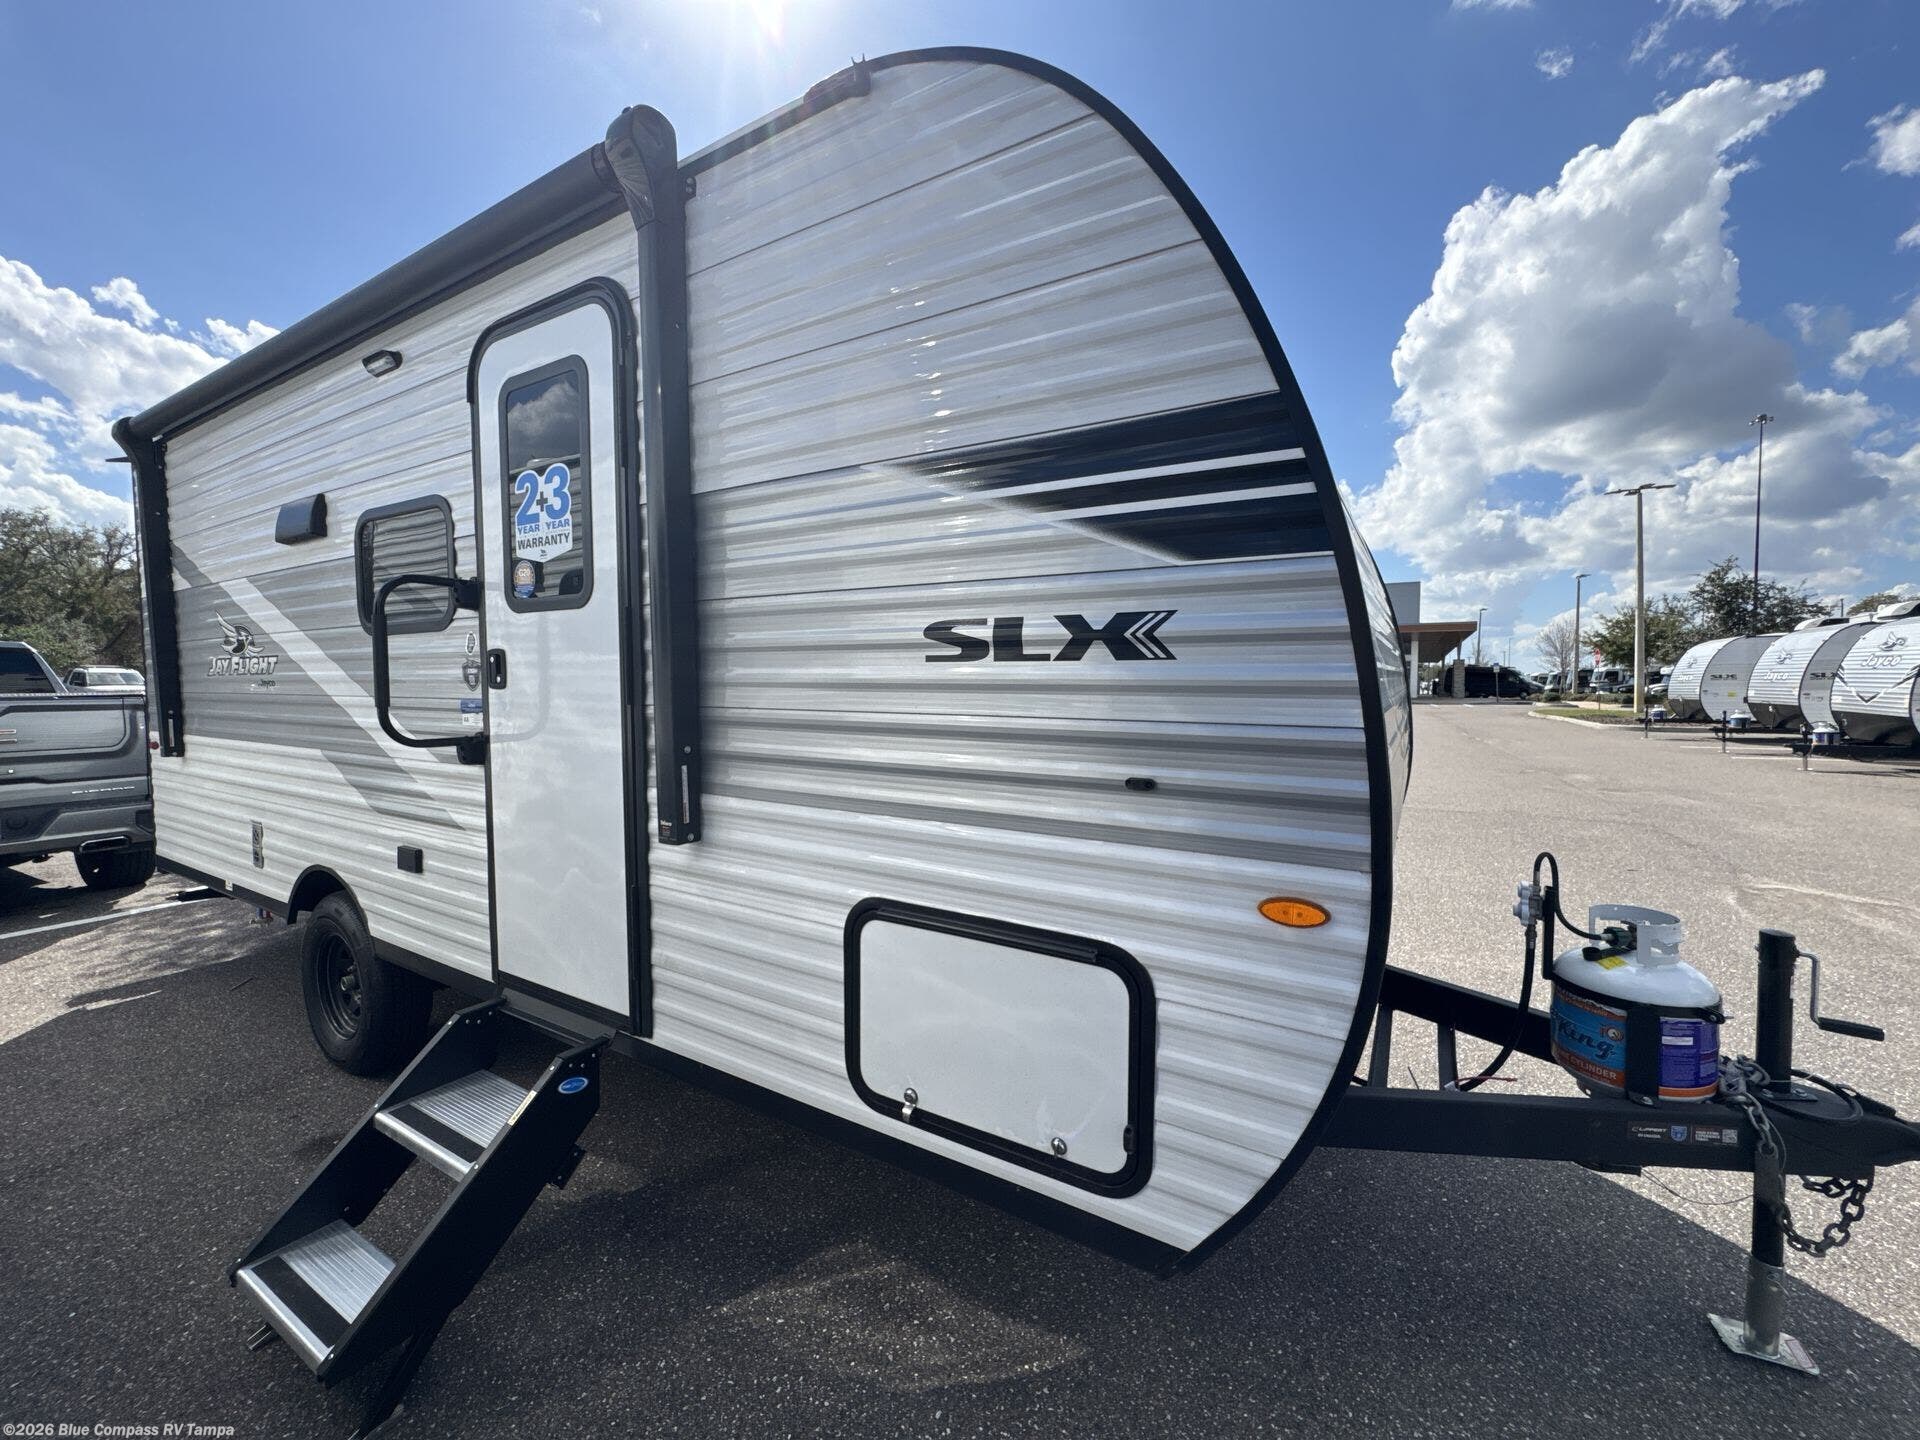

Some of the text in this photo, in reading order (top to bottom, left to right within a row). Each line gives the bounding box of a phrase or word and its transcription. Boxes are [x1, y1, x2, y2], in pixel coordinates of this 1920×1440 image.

[517, 524, 540, 535] YEAR
[545, 519, 570, 530] YEAR
[517, 533, 570, 550] WARRANTY
[923, 611, 1177, 662] SLX
[207, 655, 278, 676] JAY FLIGHT
[1860, 654, 1902, 669] Jayco
[1764, 671, 1789, 682] Jayco
